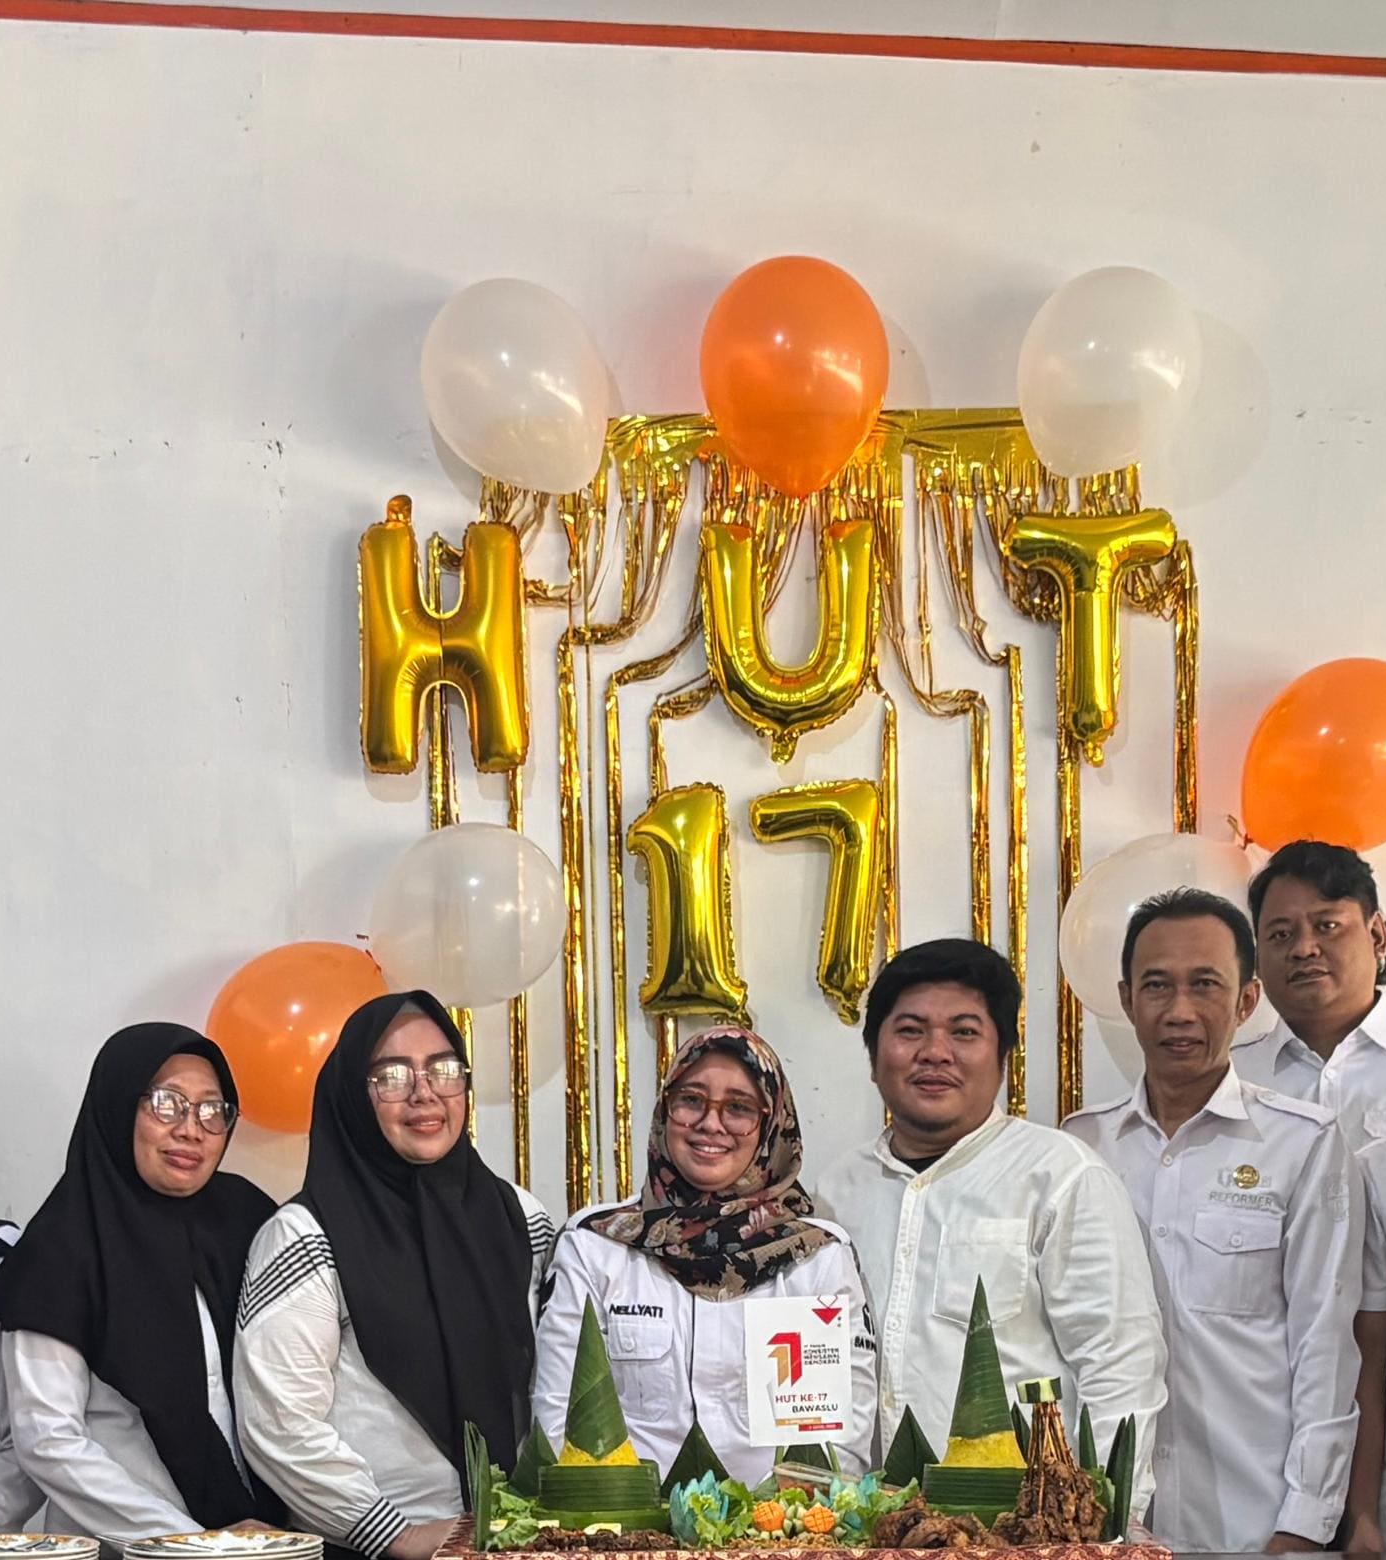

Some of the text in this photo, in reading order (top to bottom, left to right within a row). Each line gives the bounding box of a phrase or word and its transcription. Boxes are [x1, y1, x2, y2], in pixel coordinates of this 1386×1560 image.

[625, 780, 886, 1025] 17
[775, 1394, 797, 1404] HUT
[792, 1404, 839, 1414] BAWASLU
